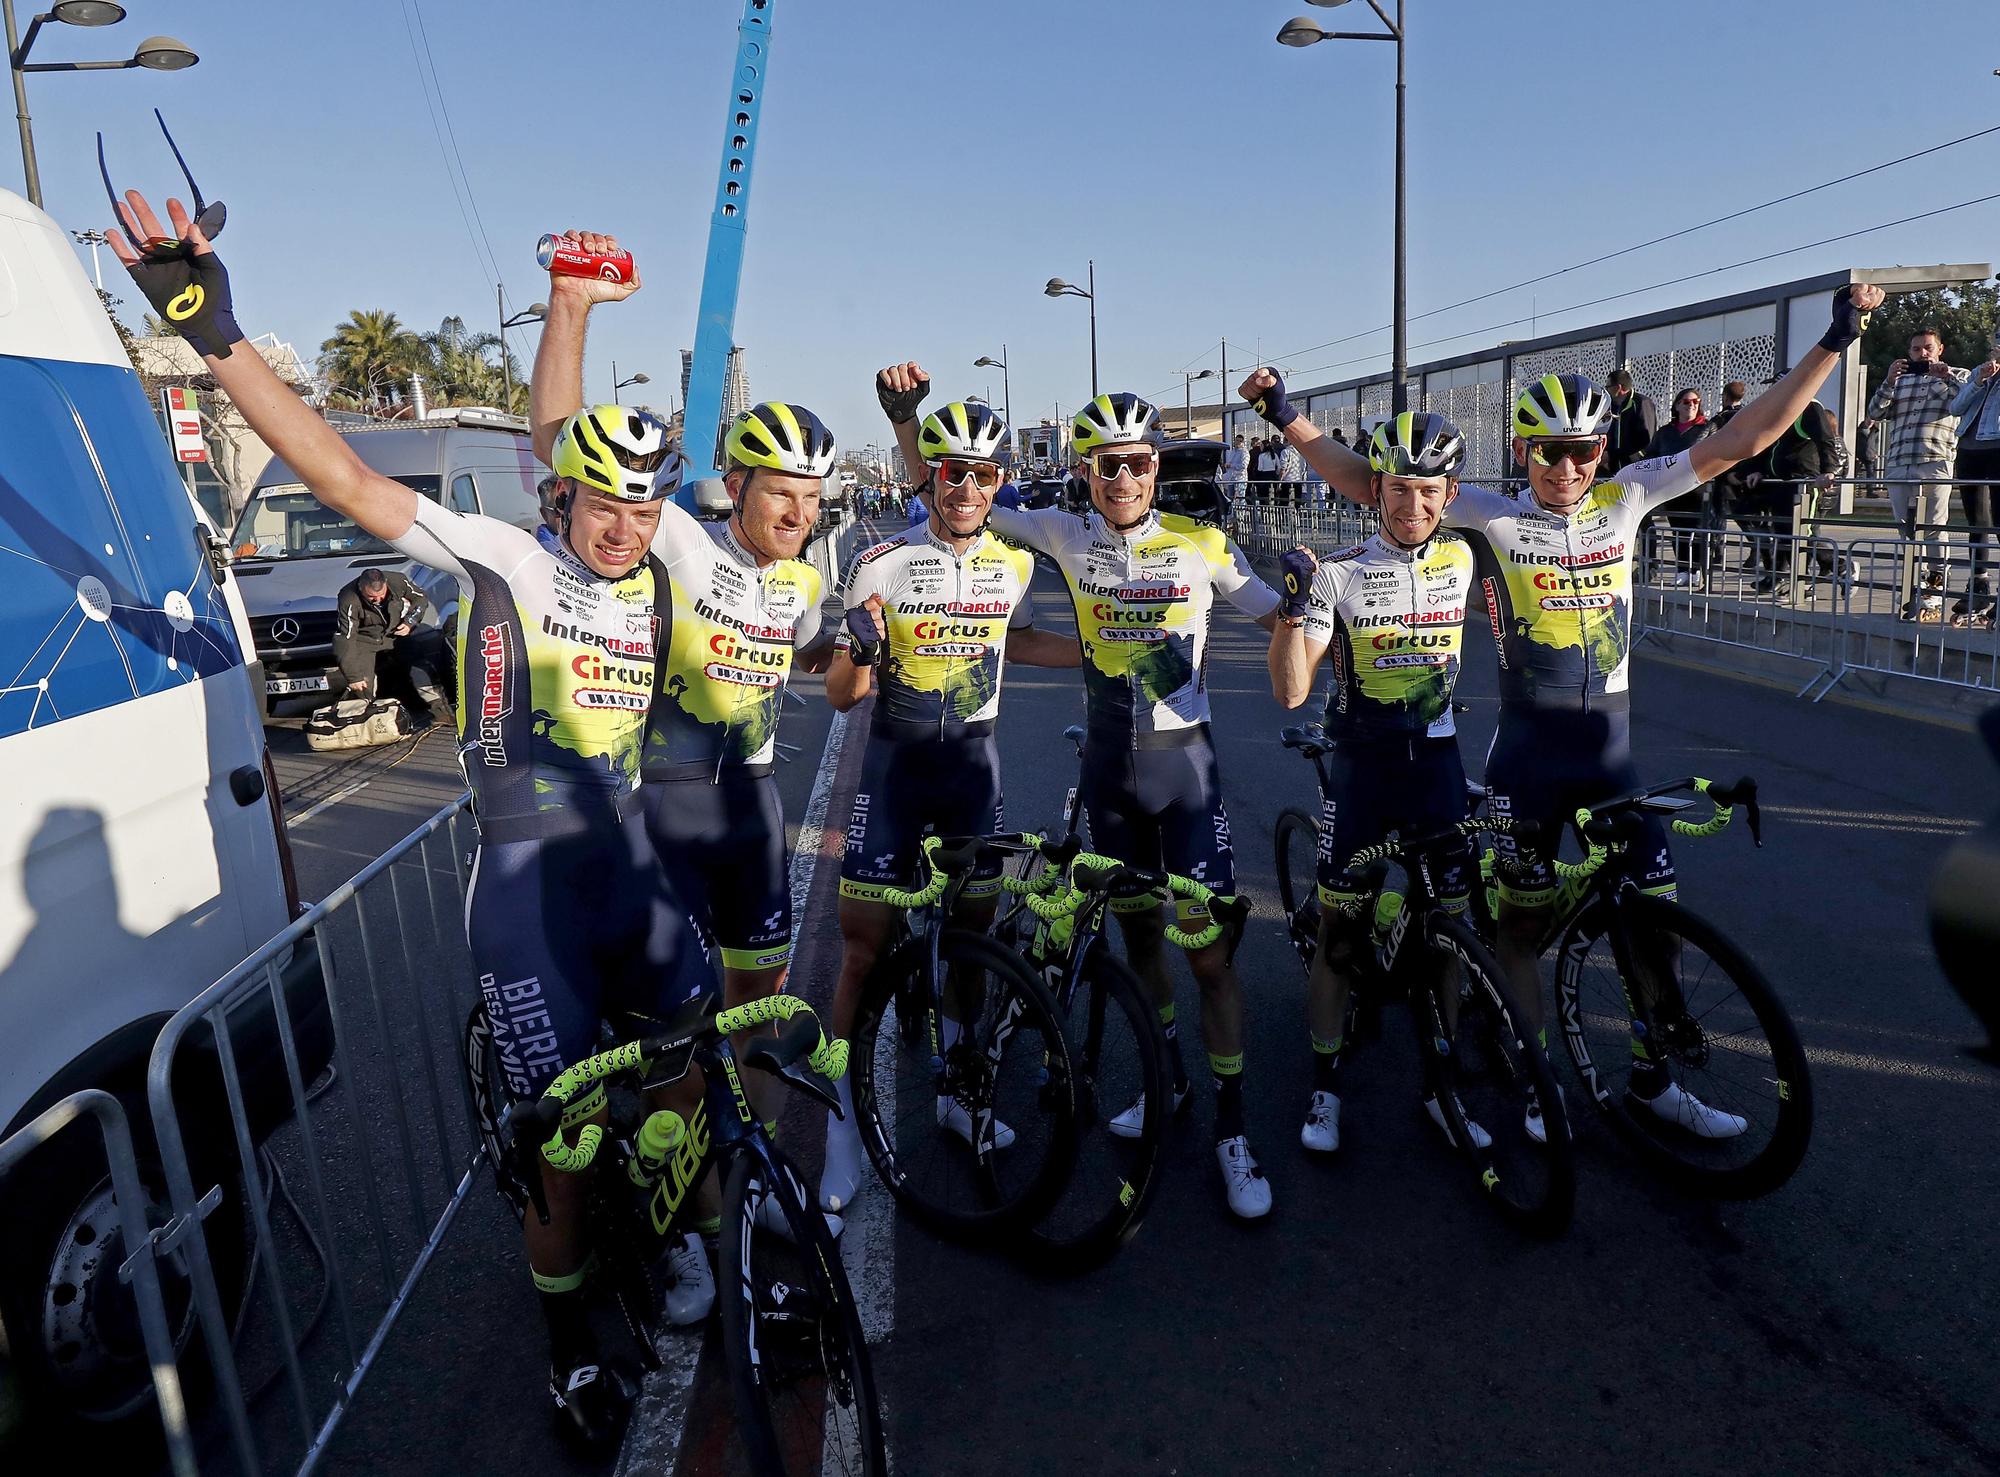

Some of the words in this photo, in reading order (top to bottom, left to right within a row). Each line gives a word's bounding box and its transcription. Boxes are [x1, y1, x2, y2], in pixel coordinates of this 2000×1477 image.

[556, 252, 582, 263] RECYCLE
[1113, 431, 1132, 439] uvex
[962, 445, 982, 453] uvex
[797, 463, 816, 473] uvex
[1516, 527, 1552, 536] STEVENY
[1593, 530, 1616, 543] Nalini
[1091, 540, 1116, 553] uvex
[909, 557, 942, 567] uvex
[1431, 563, 1454, 573] CUBE
[715, 562, 744, 581] uvex
[910, 567, 945, 577] GOBERT
[1154, 571, 1180, 581] Nalini
[1363, 571, 1396, 580] uvex
[712, 569, 747, 591] GOBERT
[1362, 580, 1399, 590] GOBERT
[1533, 573, 1612, 591] Circus
[554, 577, 599, 601] GOBERT
[623, 589, 644, 598] CUBE
[983, 586, 1006, 596] Nalini
[1550, 596, 1607, 608] WANTY
[1092, 603, 1167, 623] Circus
[914, 621, 991, 640] Circus
[1106, 629, 1160, 639] WANTY
[1371, 632, 1452, 651] Circus
[709, 634, 785, 666] Circus
[923, 645, 980, 655] WANTY
[1383, 655, 1441, 666] WANTY
[571, 654, 653, 687] Circus
[716, 667, 774, 684] WANTY
[587, 693, 646, 708] WANTY
[847, 793, 872, 854] BIERE
[1420, 864, 1435, 898] CUBE
[1381, 903, 1412, 973] CUBE
[480, 972, 504, 1016] DES
[501, 975, 565, 1079] BIERE
[661, 1035, 693, 1051] CUBE
[487, 1015, 532, 1096] AMIS
[720, 1056, 752, 1123] CUBE
[649, 1096, 711, 1236] CUBE
